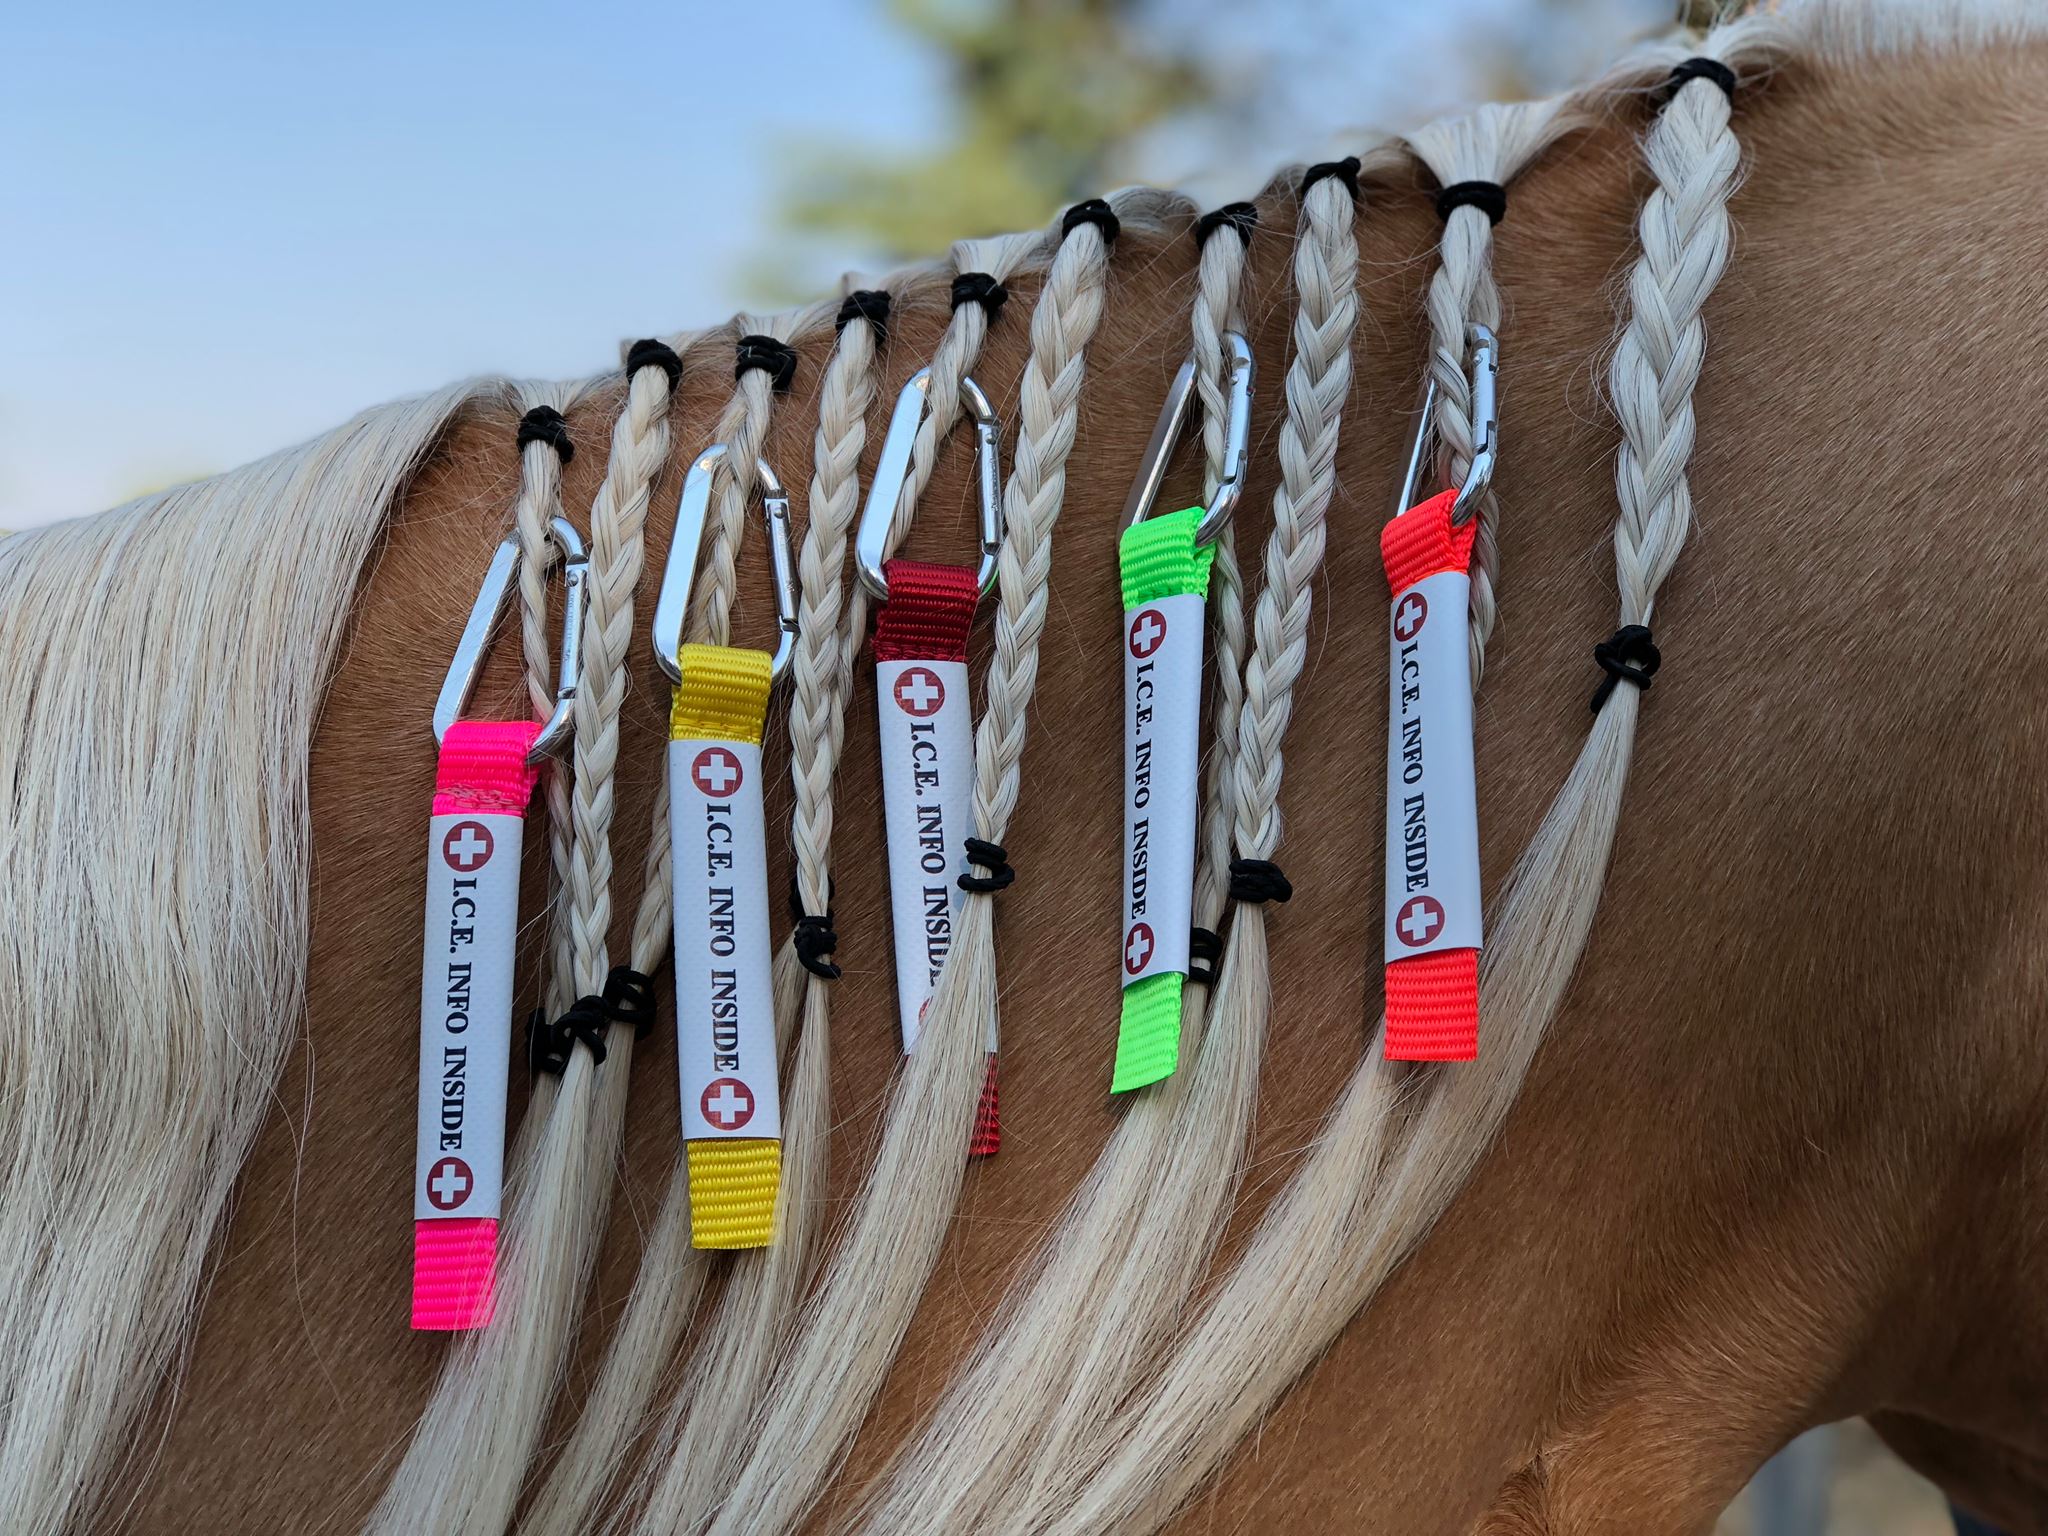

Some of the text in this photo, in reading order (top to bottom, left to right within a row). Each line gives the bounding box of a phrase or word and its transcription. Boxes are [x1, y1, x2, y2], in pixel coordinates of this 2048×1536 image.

[910, 721, 939, 797] I.C.E.
[917, 803, 946, 875] INFO
[1131, 660, 1154, 920] I.C.E. INFO INSIDE
[1401, 640, 1429, 893] I.C.E. INFO INSIDE
[439, 878, 477, 1152] I.C.E. INFO INSIDE
[706, 802, 740, 1073] I.C.E. INFO INSIDE
